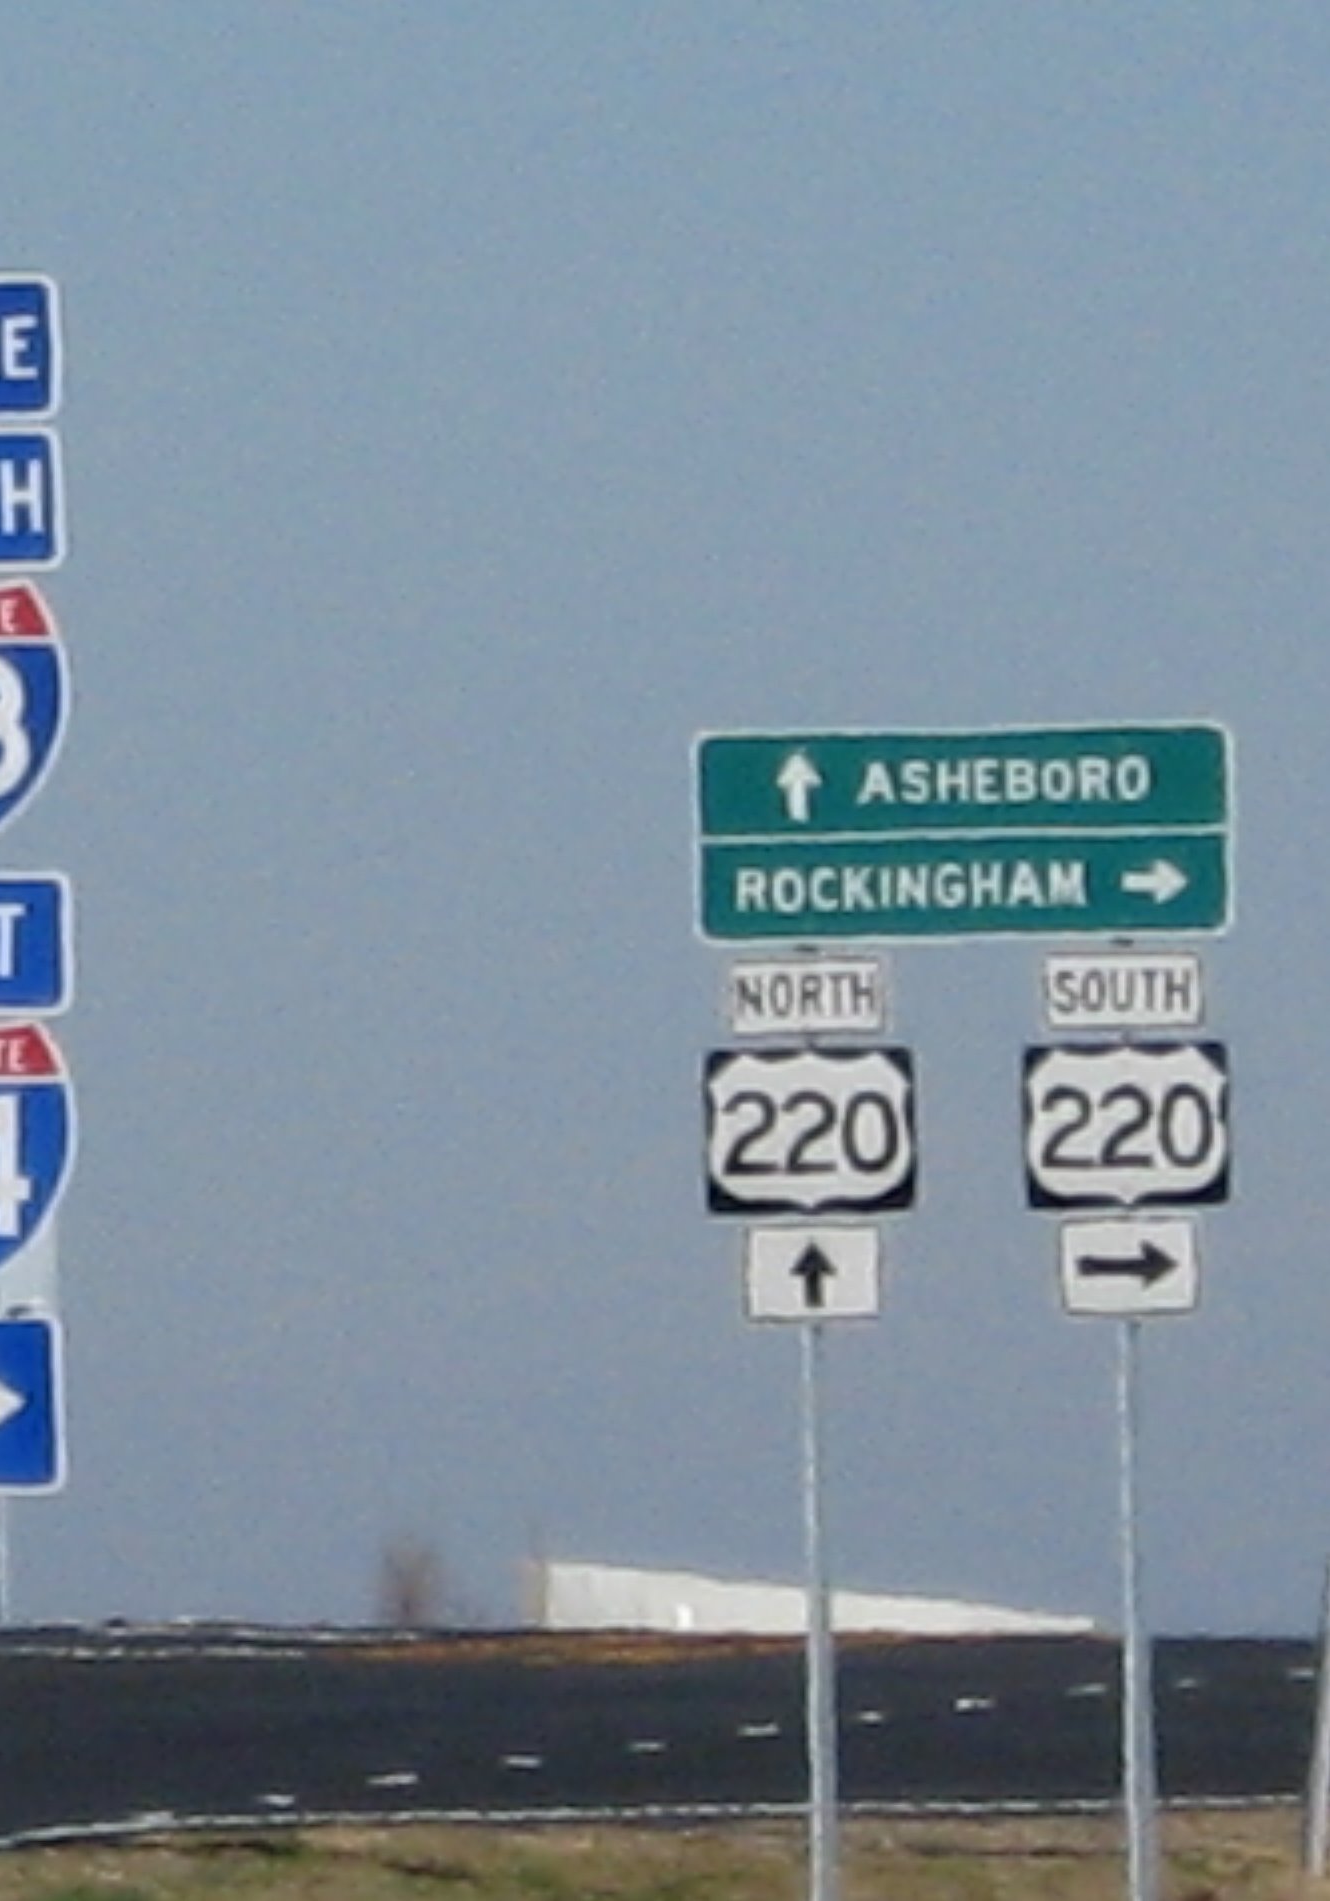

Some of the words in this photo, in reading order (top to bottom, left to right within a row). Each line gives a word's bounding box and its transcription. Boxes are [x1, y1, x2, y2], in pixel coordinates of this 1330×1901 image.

[857, 756, 1151, 805] ASHEBORO
[736, 861, 1087, 912] ROCKINGHAM
[735, 972, 876, 1017] NORTH
[1052, 968, 1191, 1014] SOUTH
[722, 1090, 900, 1175] 220
[1041, 1084, 1214, 1169] 220
